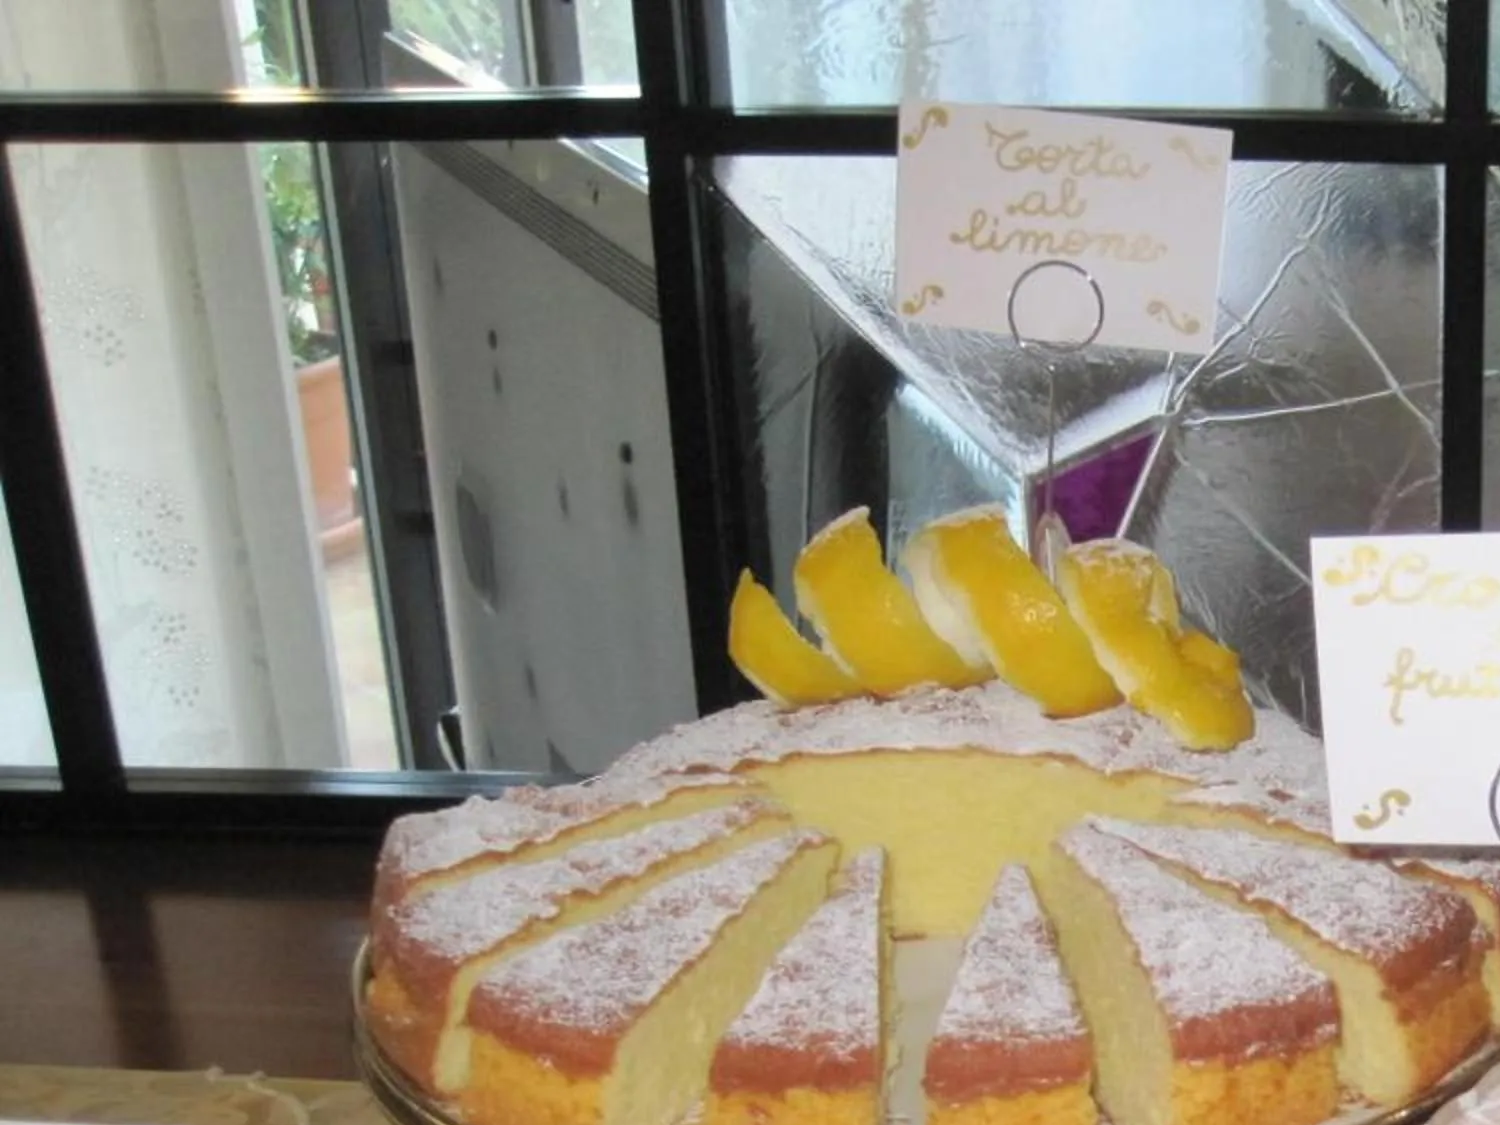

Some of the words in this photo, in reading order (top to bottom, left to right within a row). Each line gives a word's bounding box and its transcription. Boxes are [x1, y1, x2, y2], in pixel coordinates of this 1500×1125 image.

[984, 119, 1152, 179] Torta
[1006, 177, 1087, 218] al
[950, 208, 1168, 263] limone
